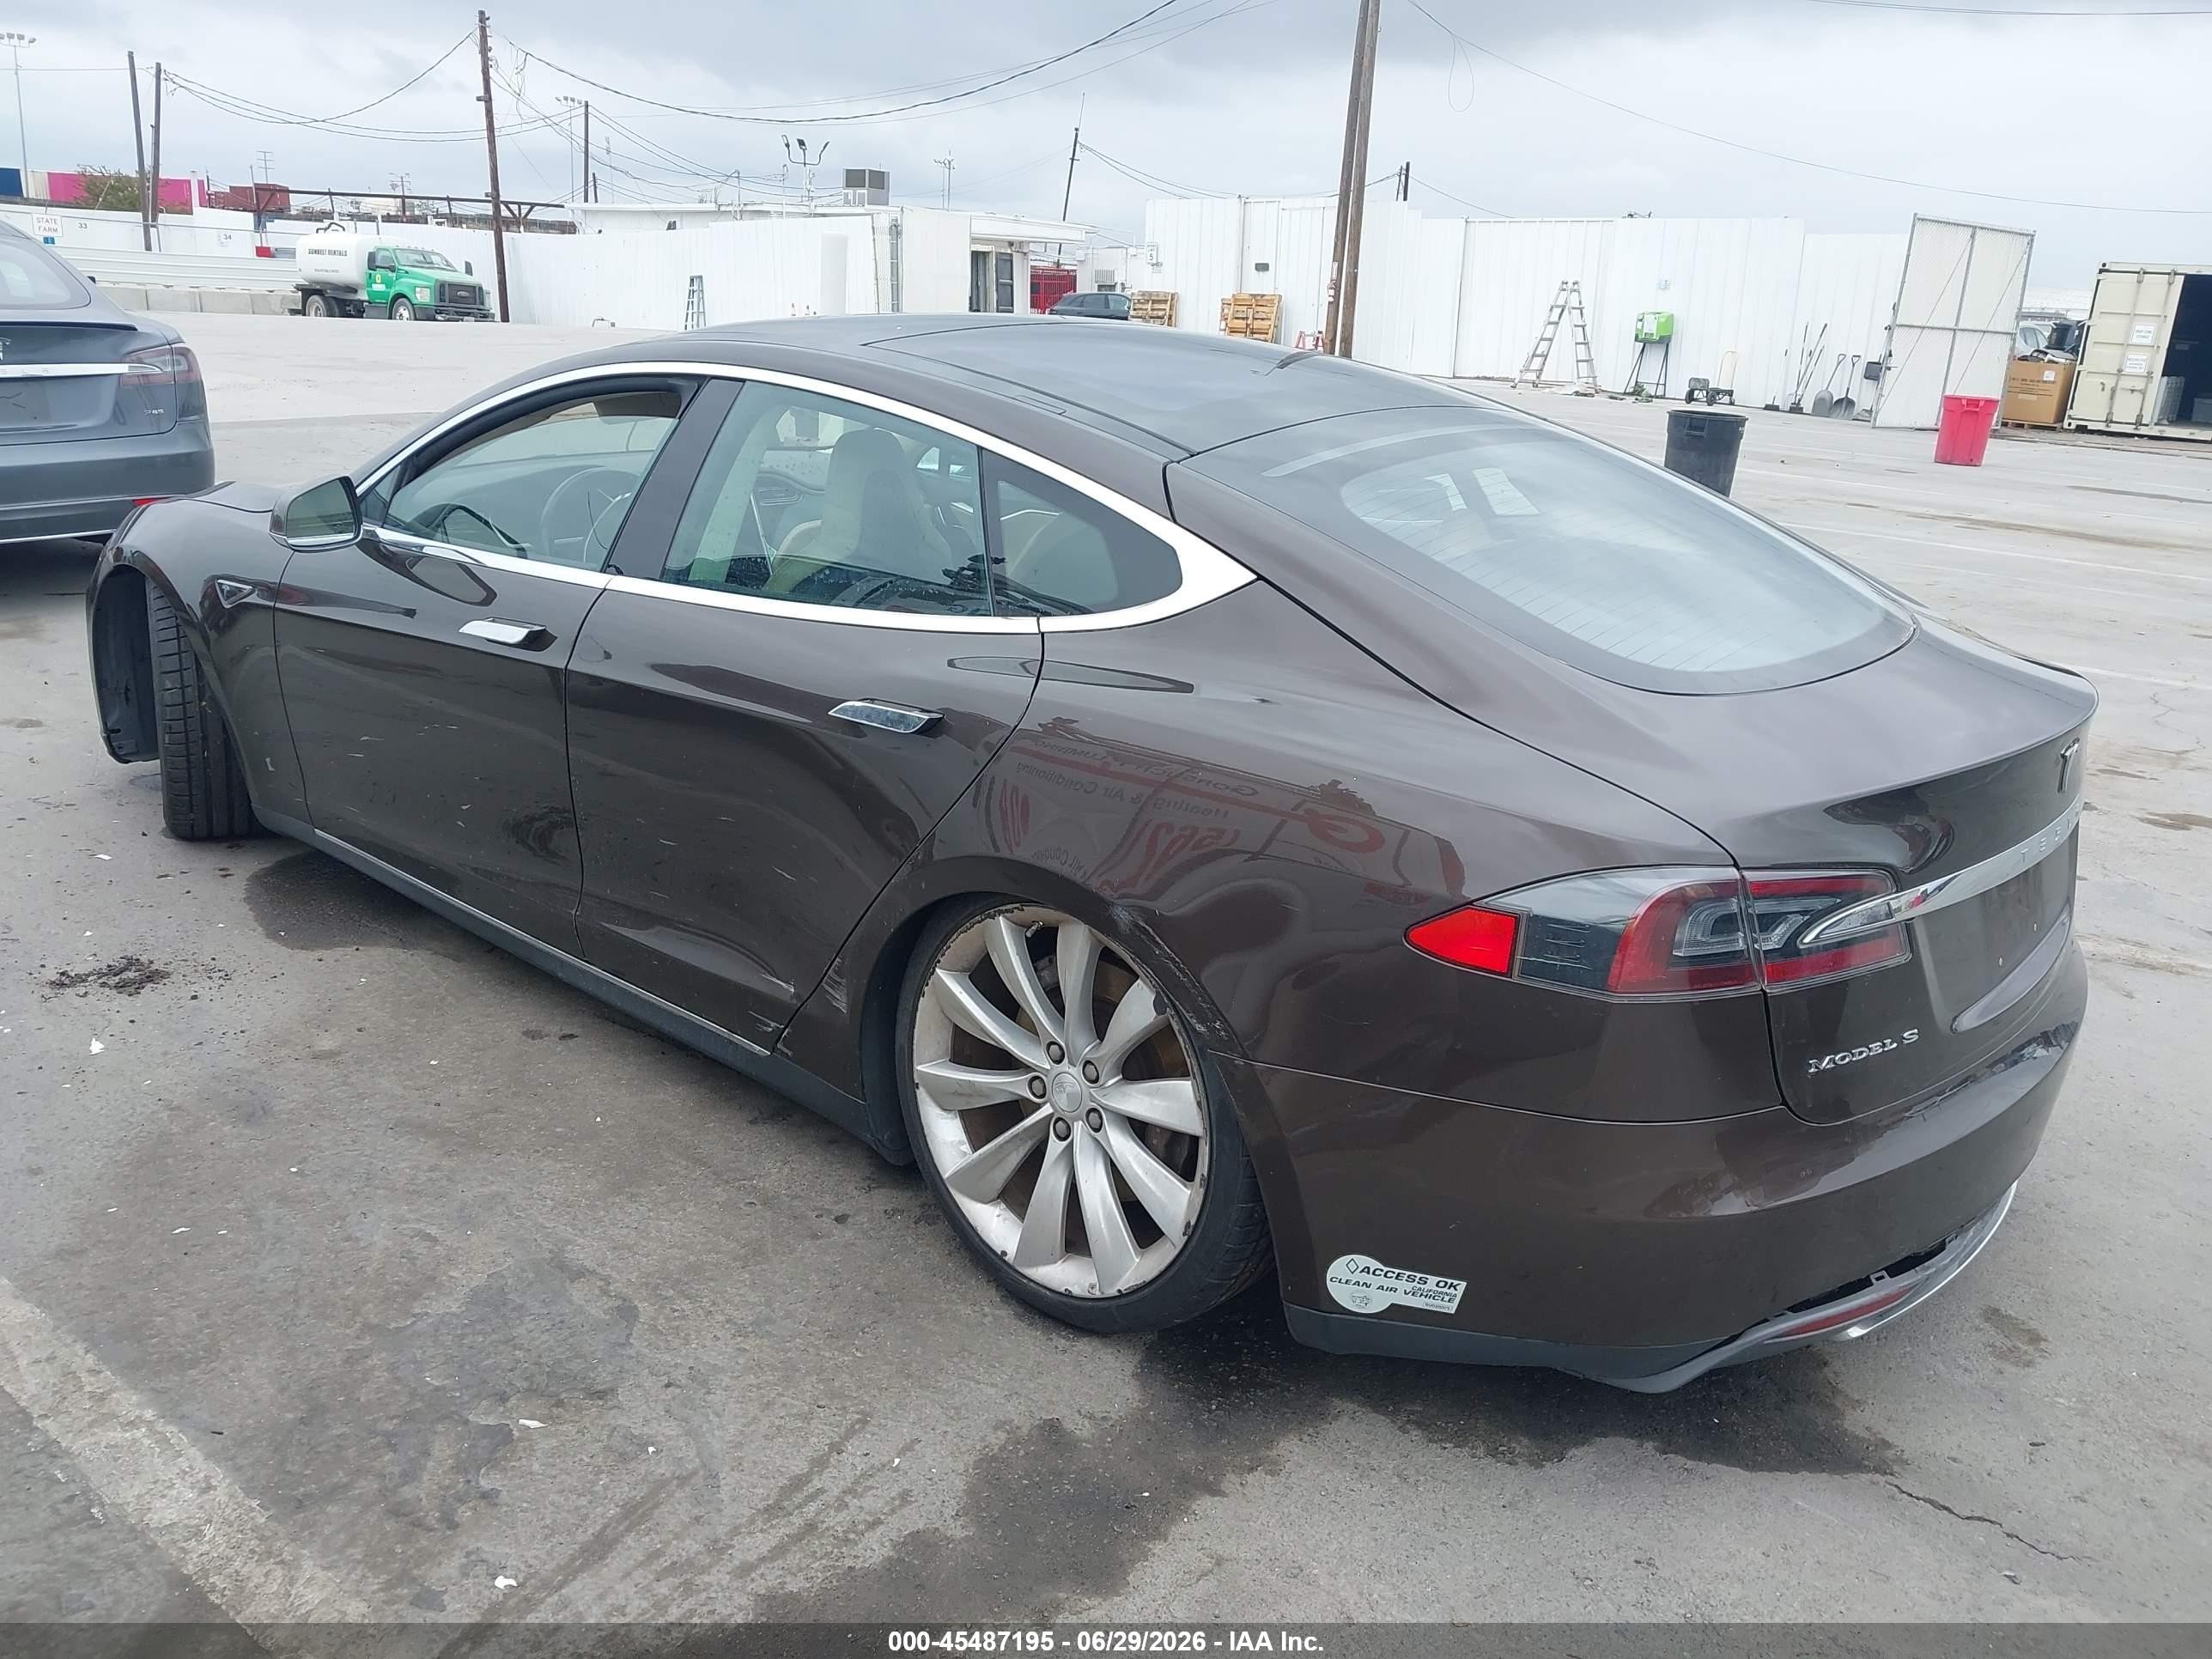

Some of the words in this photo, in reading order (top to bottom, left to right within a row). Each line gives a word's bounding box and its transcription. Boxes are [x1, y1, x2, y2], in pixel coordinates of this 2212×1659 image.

[37, 216, 58, 225] STATE
[1808, 1038, 1898, 1073] MODEL
[1902, 1029, 1919, 1044] S
[1329, 1276, 1372, 1289] CLEAN
[1376, 1285, 1399, 1294] AIR
[1403, 1289, 1456, 1304] VEHICLE
[1358, 1266, 1429, 1285] ACCESS
[1435, 1279, 1462, 1291] OK
[1411, 1285, 1458, 1298] CALIFORNIA
